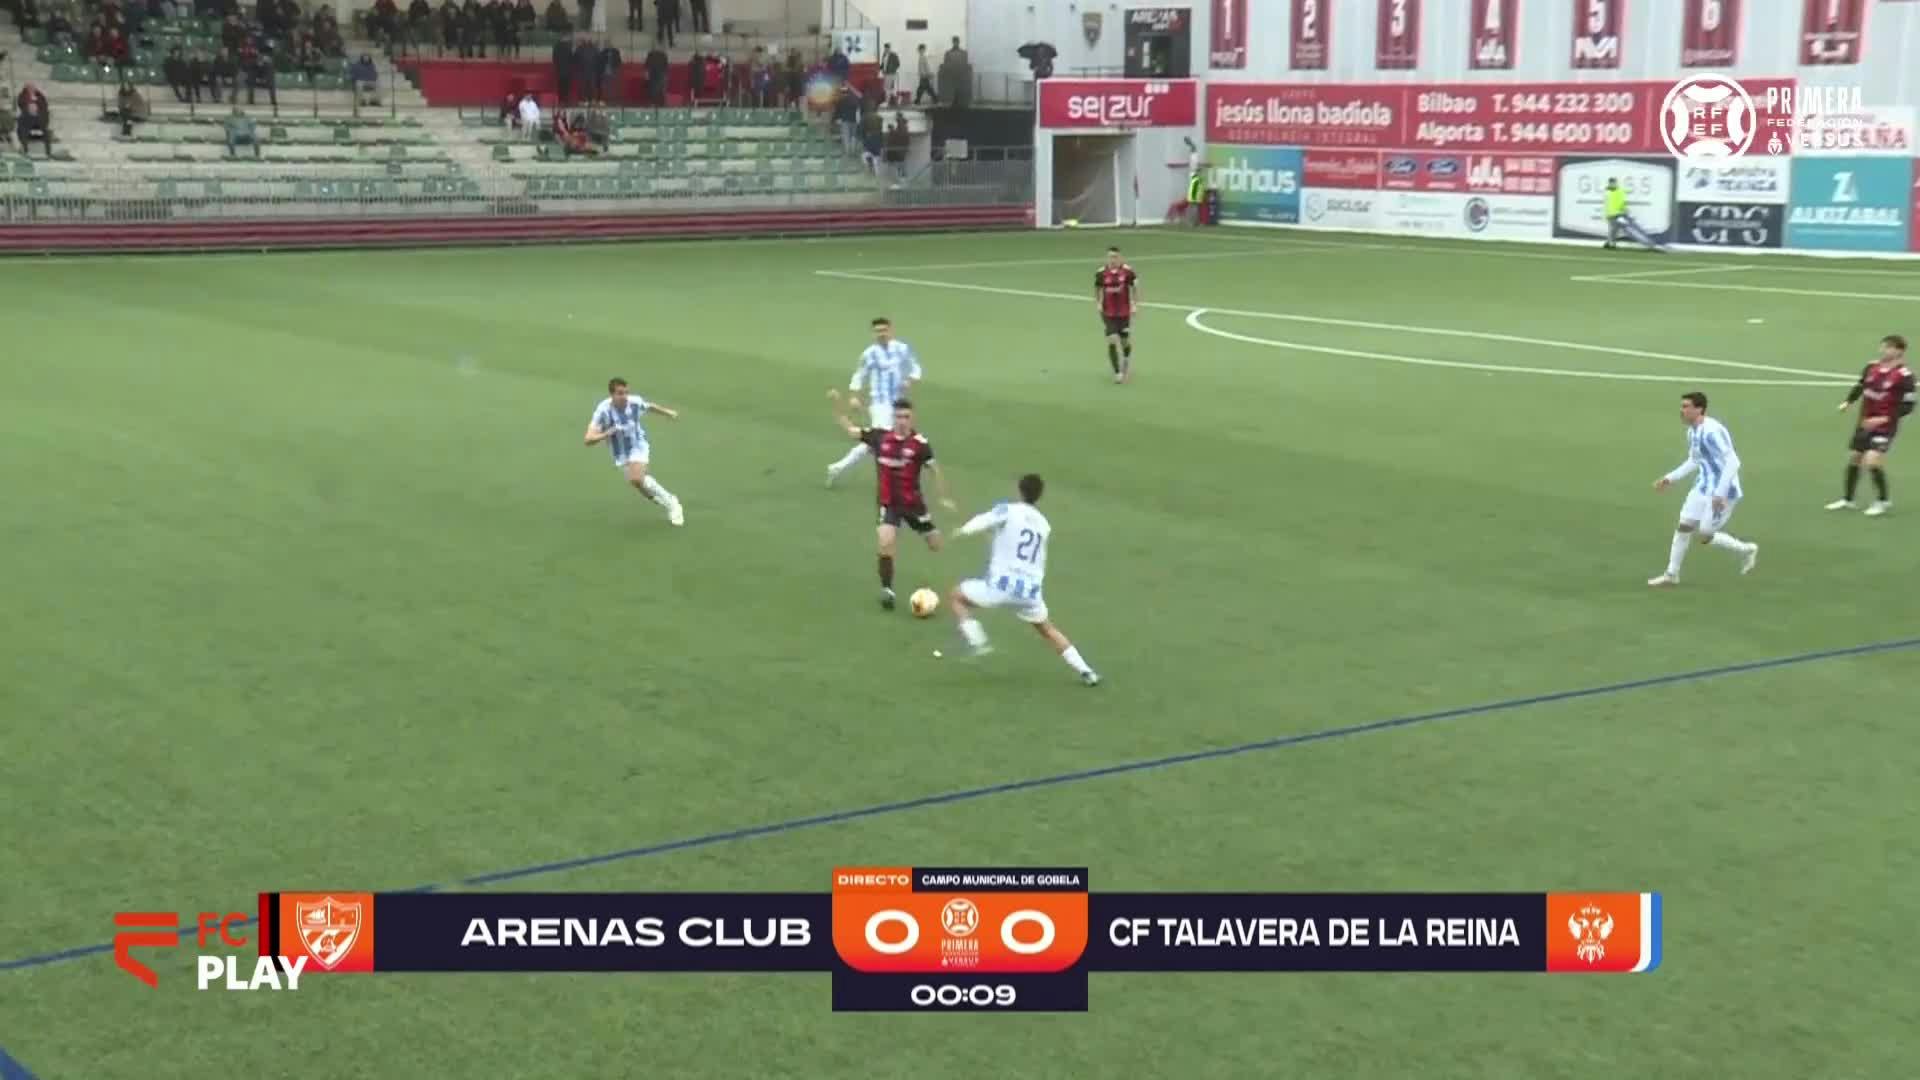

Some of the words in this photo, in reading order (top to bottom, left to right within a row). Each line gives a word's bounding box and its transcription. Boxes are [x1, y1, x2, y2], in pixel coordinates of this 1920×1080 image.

[1067, 95, 1154, 125] selzur
[1267, 97, 1314, 125] llona
[1417, 93, 1477, 113] Bilbao
[1511, 94, 1550, 113] 944
[1552, 93, 1590, 113] 232
[1592, 93, 1633, 113] 300
[1416, 121, 1484, 146] Algorta
[1511, 123, 1550, 142] 944
[1552, 122, 1591, 142] 600
[1594, 122, 1632, 143] 100
[1016, 528, 1042, 564] 21
